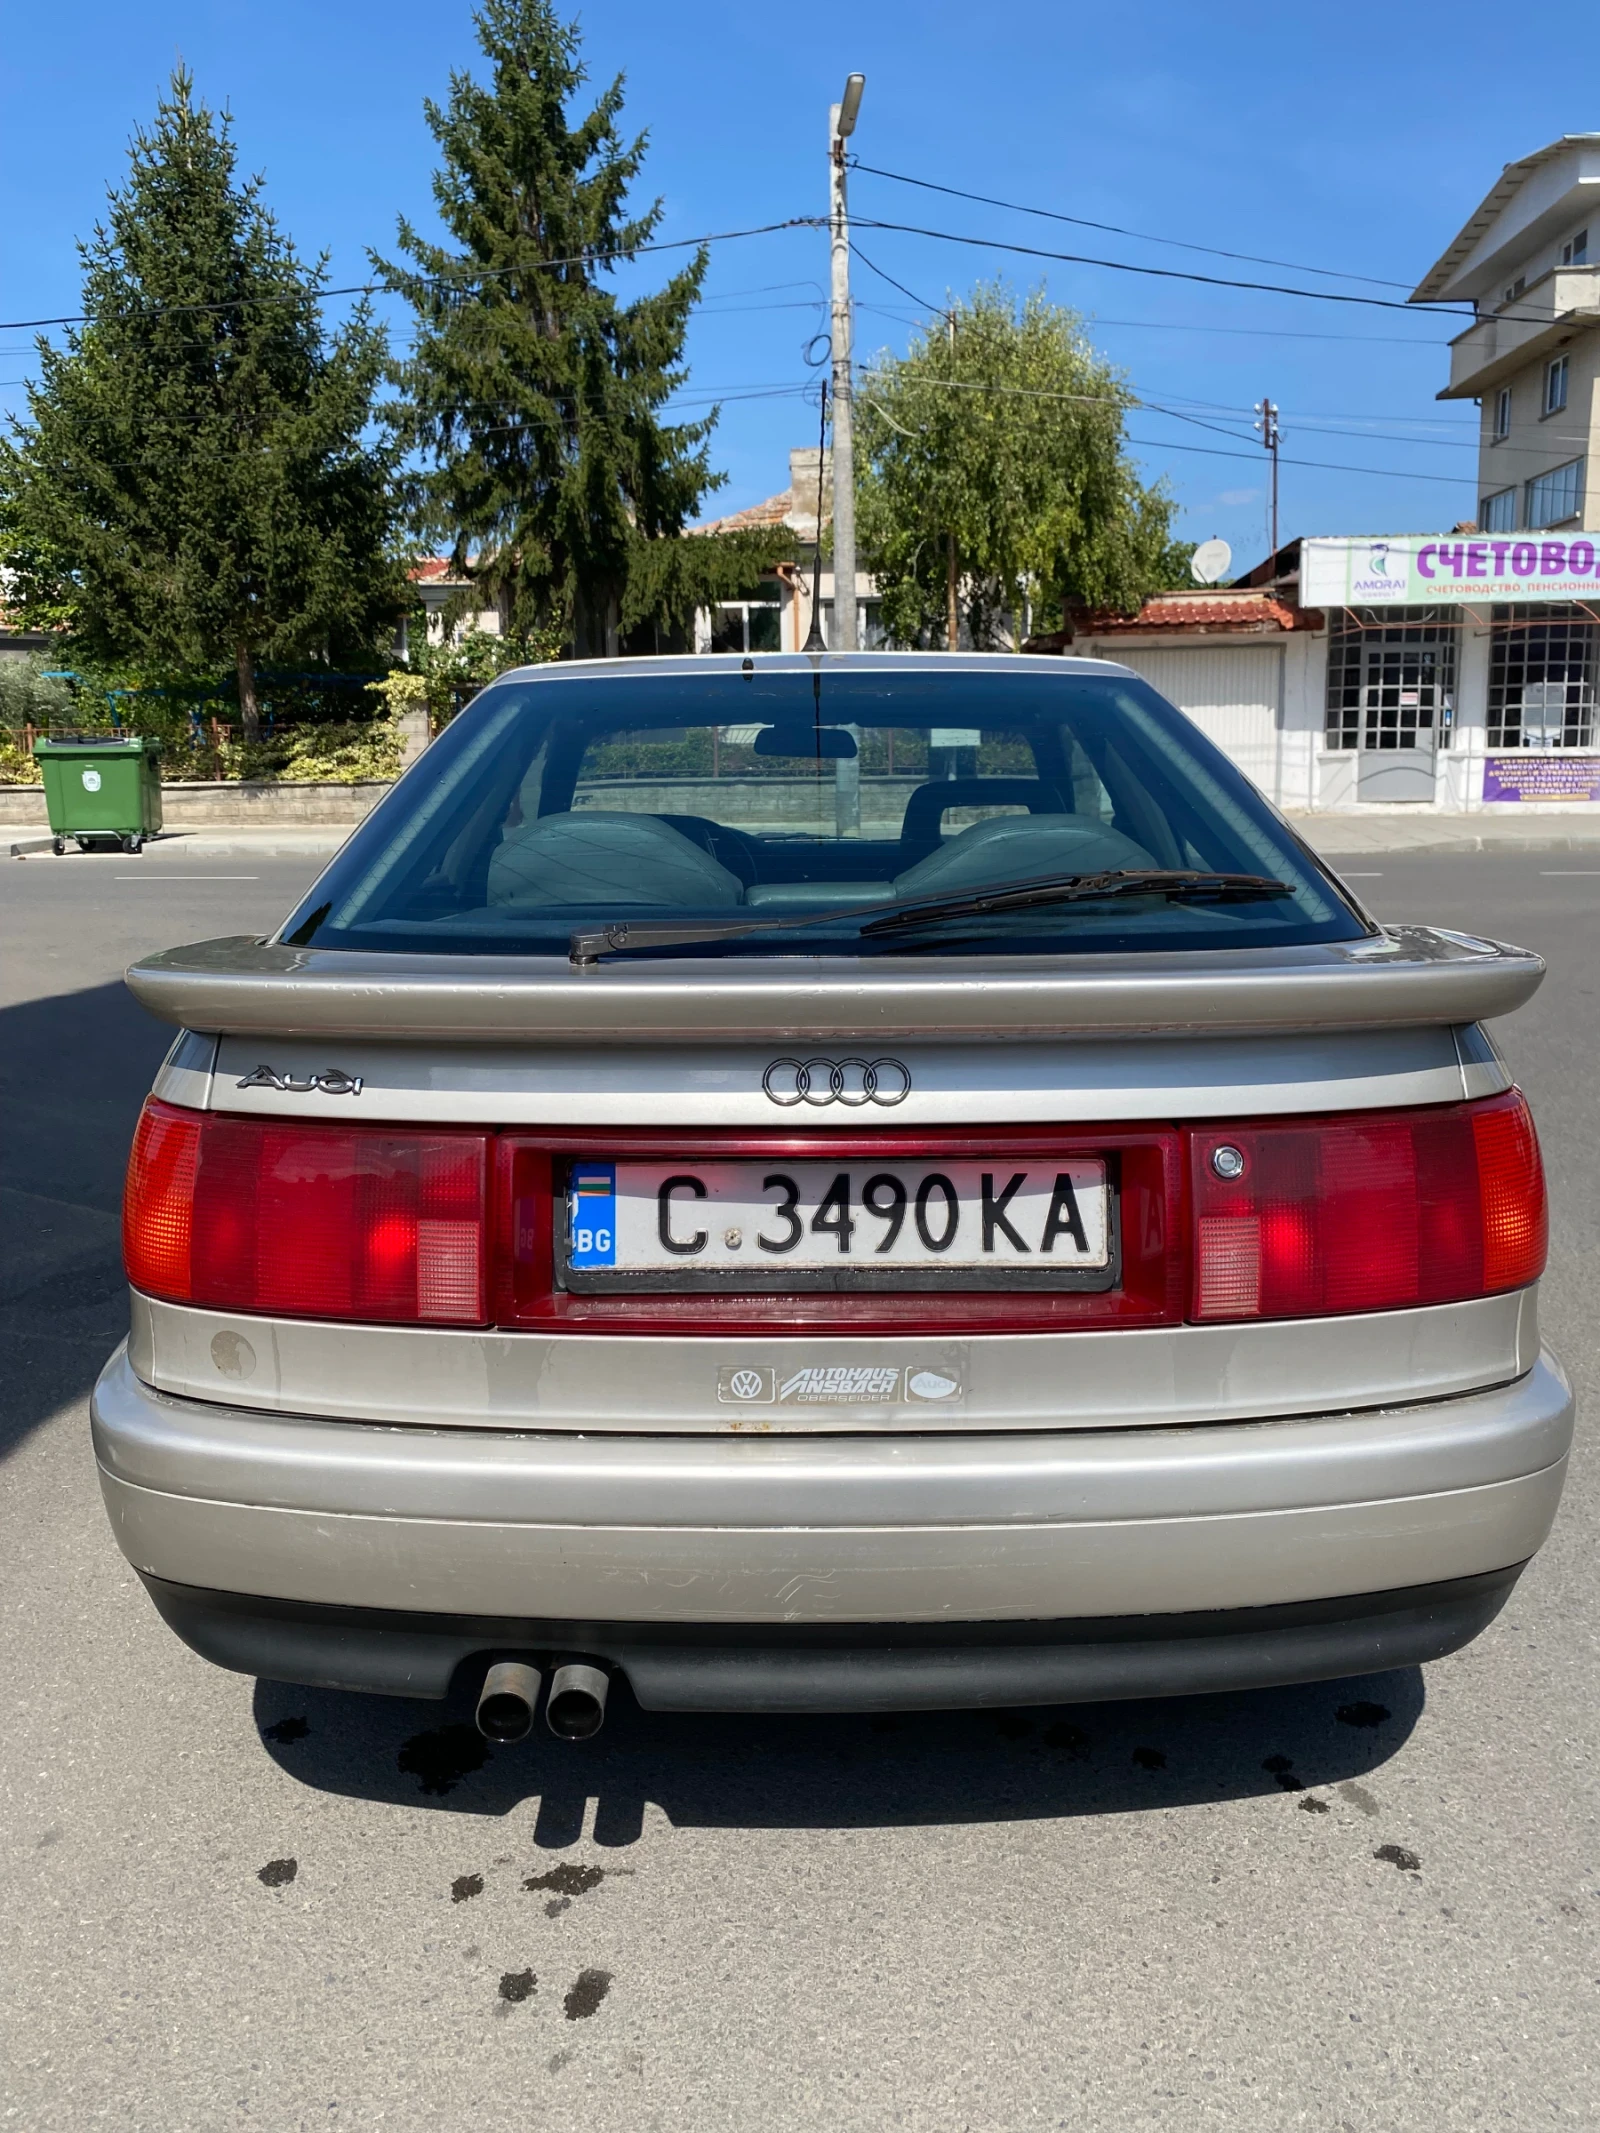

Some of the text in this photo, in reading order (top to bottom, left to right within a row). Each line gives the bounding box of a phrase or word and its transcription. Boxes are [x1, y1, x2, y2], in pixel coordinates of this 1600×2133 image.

[1417, 541, 1600, 578] СЧЕТОВО
[1353, 580, 1405, 590] AMORAI
[236, 1065, 363, 1096] Audi
[657, 1173, 1090, 1255] C 3490 KA
[577, 1229, 611, 1253] BG
[782, 1367, 900, 1384] AUTOHAUS
[782, 1380, 896, 1394] ANSBACH
